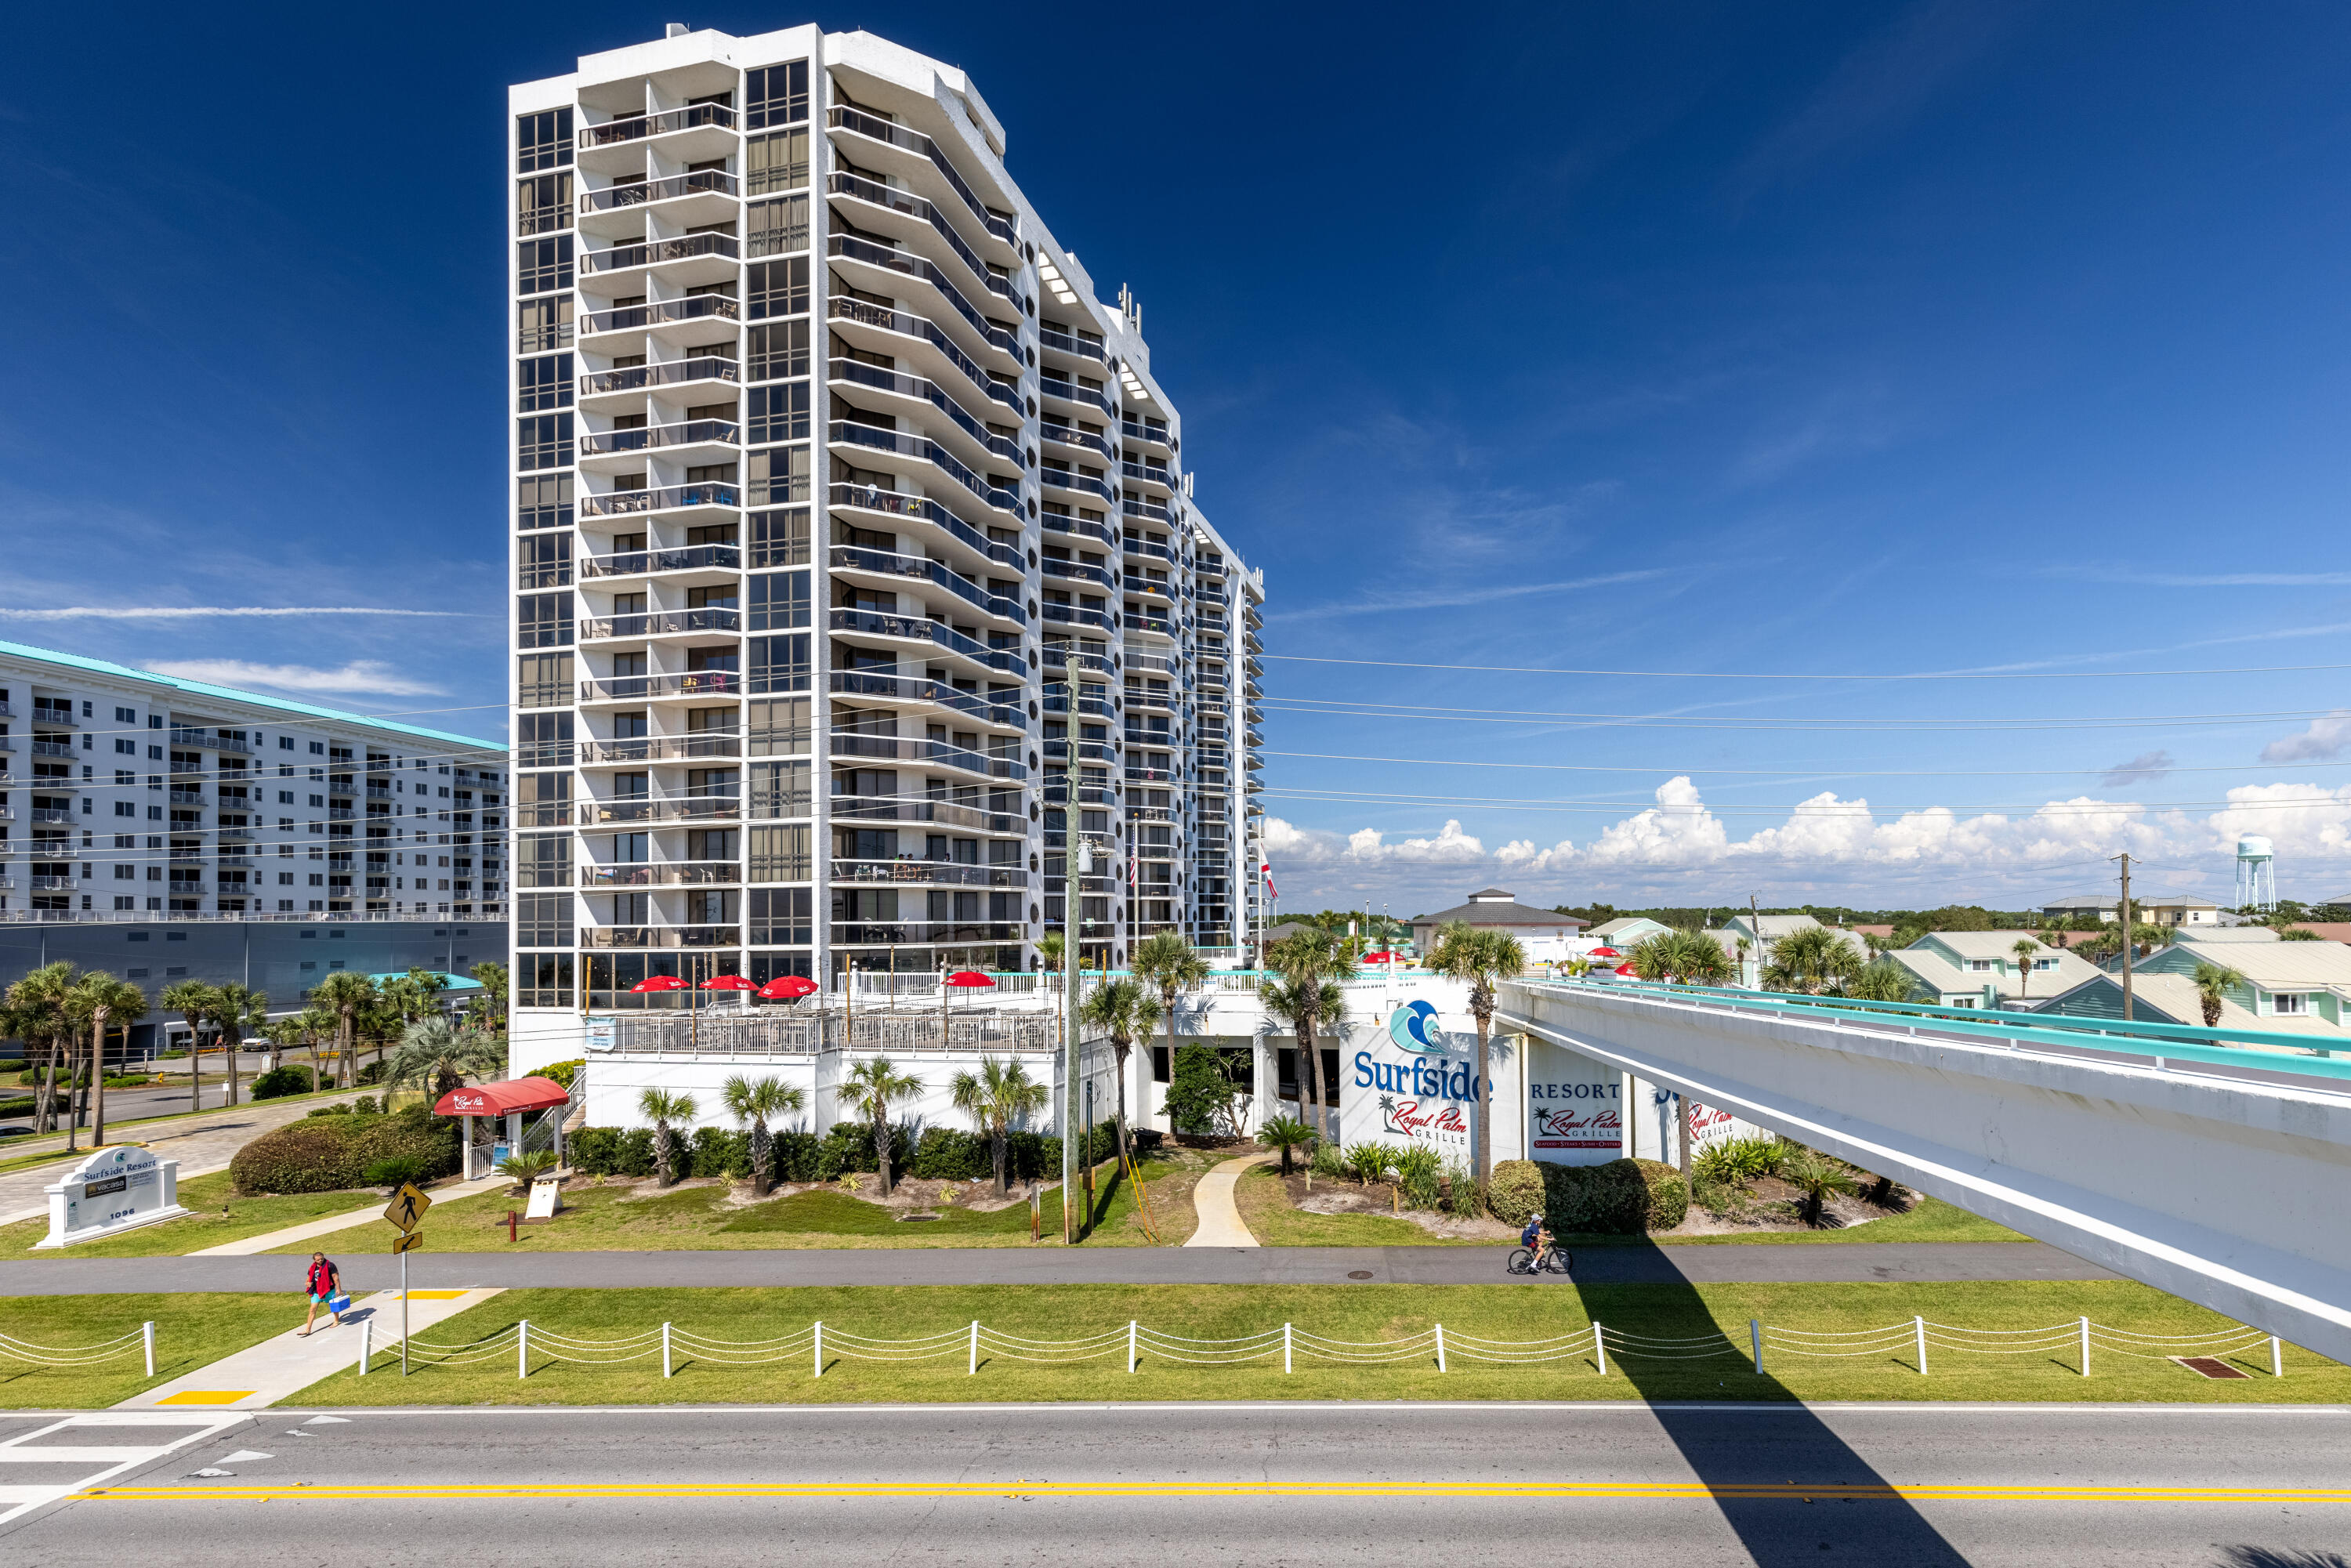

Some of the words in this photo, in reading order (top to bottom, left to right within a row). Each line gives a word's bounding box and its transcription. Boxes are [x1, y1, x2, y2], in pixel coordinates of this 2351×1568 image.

[1531, 1084, 1620, 1099] RESORT
[1392, 1101, 1434, 1136] Royal
[1434, 1107, 1467, 1133] Palm
[1548, 1110, 1591, 1137] Royal
[1591, 1110, 1622, 1128] Palm
[1415, 1129, 1465, 1145] GRILLE
[1701, 1124, 1733, 1138] GRILLE
[84, 1166, 124, 1182] Surfside
[126, 1159, 157, 1172] Resort
[96, 1179, 125, 1191] vacasa
[110, 1208, 135, 1219] 1096
